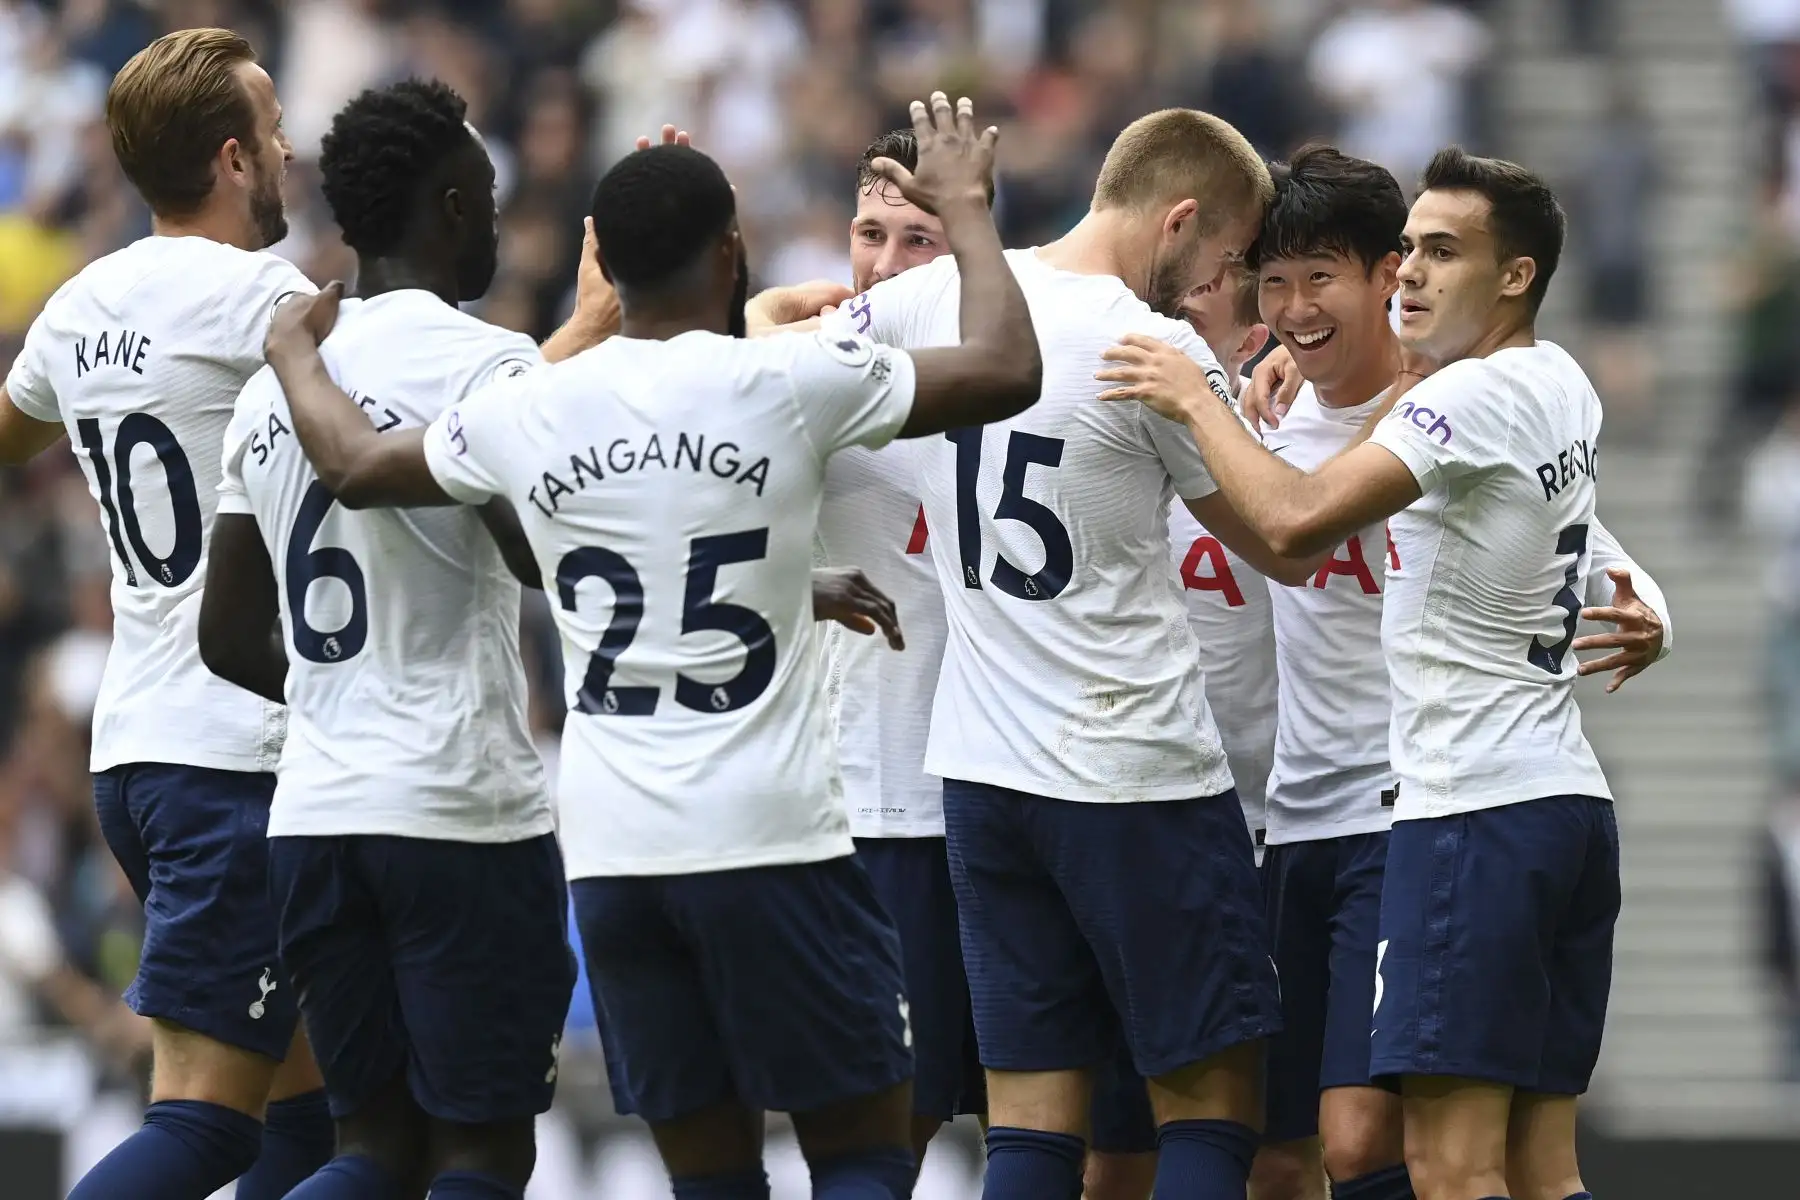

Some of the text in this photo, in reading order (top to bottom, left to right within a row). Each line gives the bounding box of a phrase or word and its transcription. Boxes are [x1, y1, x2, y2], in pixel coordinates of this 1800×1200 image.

[75, 330, 151, 378] KANE
[76, 412, 203, 588] 10
[528, 433, 770, 519] TANGANGA
[944, 423, 1074, 601] 15
[286, 478, 369, 664] 6
[555, 527, 777, 716] 25
